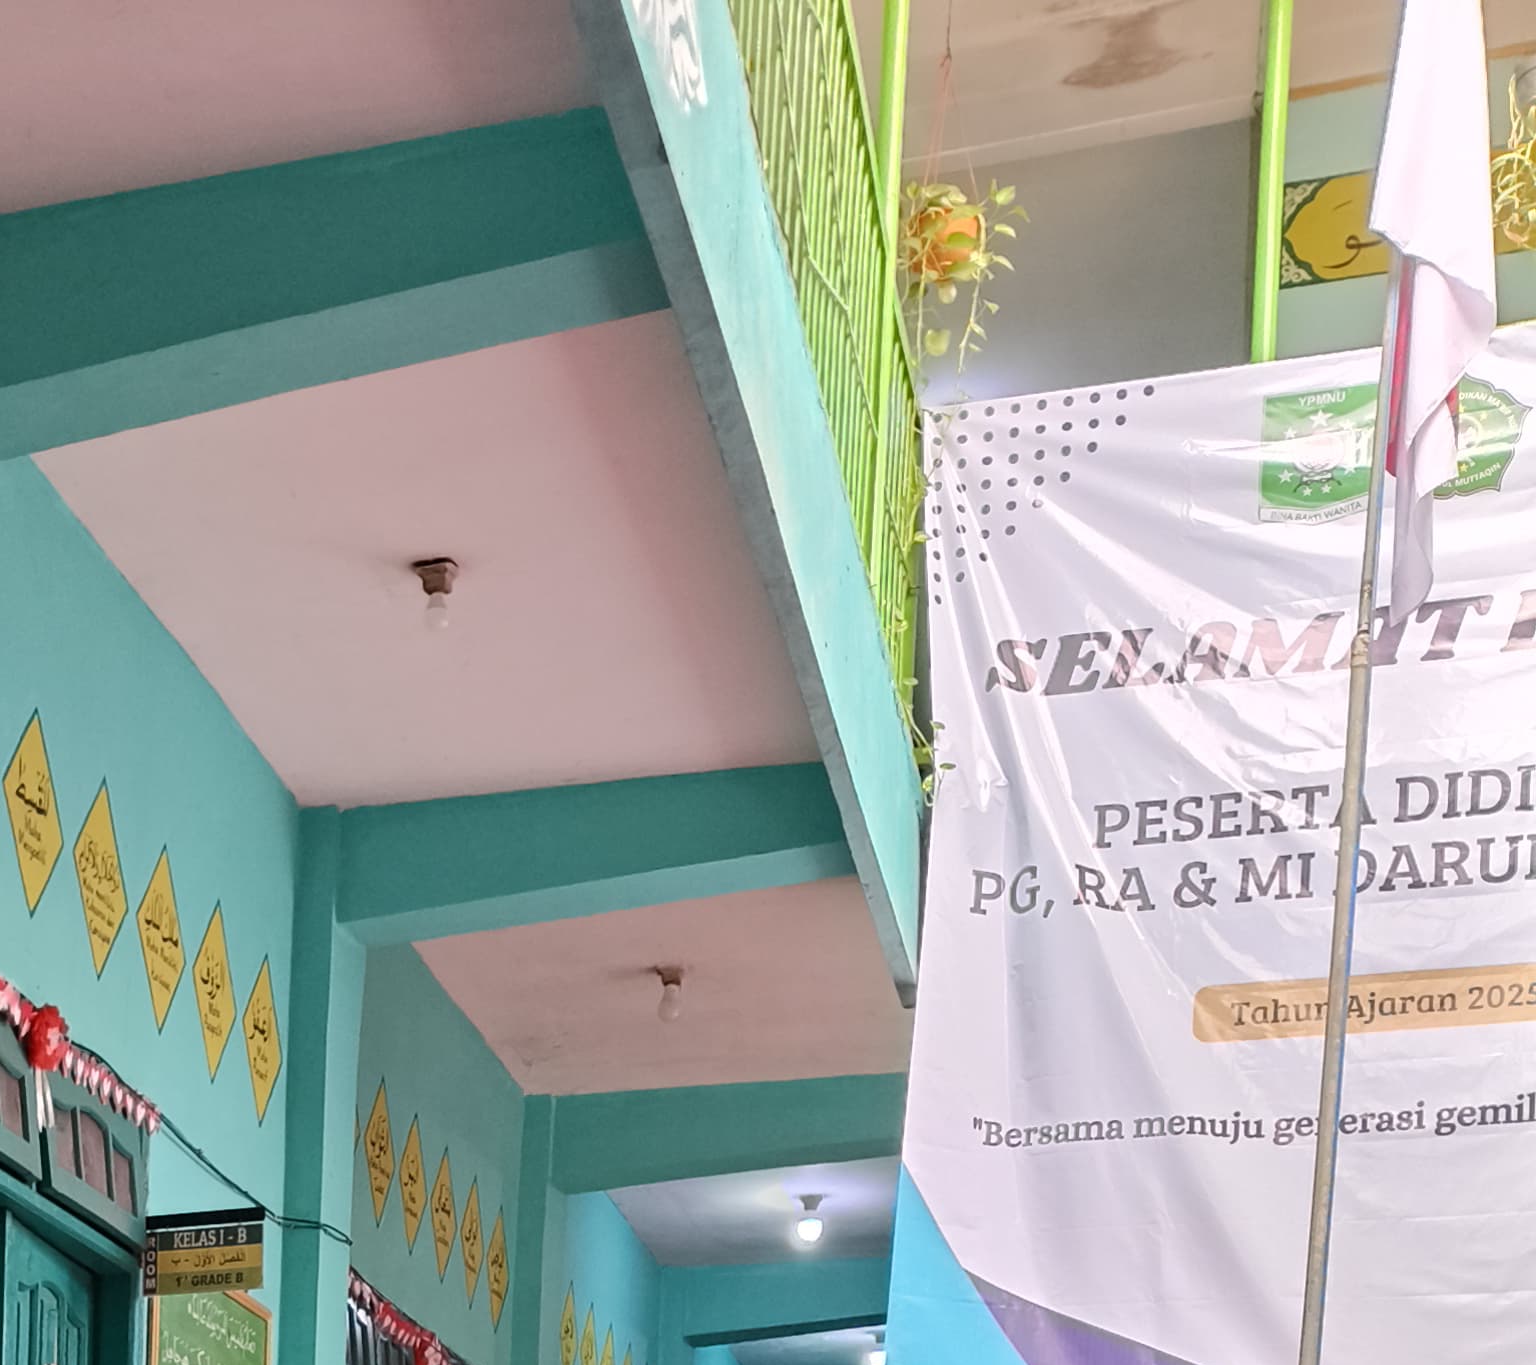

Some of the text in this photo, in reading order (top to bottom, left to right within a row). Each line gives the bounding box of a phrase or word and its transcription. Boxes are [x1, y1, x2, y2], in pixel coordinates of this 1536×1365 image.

[1298, 391, 1346, 408] YPMNU
[1324, 501, 1362, 519] WANITA
[985, 595, 1494, 696] SELAMAT
[1094, 783, 1377, 848] PESERTA
[970, 865, 1054, 919] PG,
[1073, 862, 1156, 912] RA
[1173, 860, 1217, 909] &
[1235, 851, 1316, 903] MI
[1346, 992, 1458, 1024] Ajaran
[1133, 1110, 1265, 1145] menuju
[1272, 1100, 1427, 1147] geerasi
[173, 1230, 216, 1249] KELAS
[219, 1229, 225, 1246] I
[238, 1227, 247, 1244] B
[191, 1273, 232, 1287] GRADE
